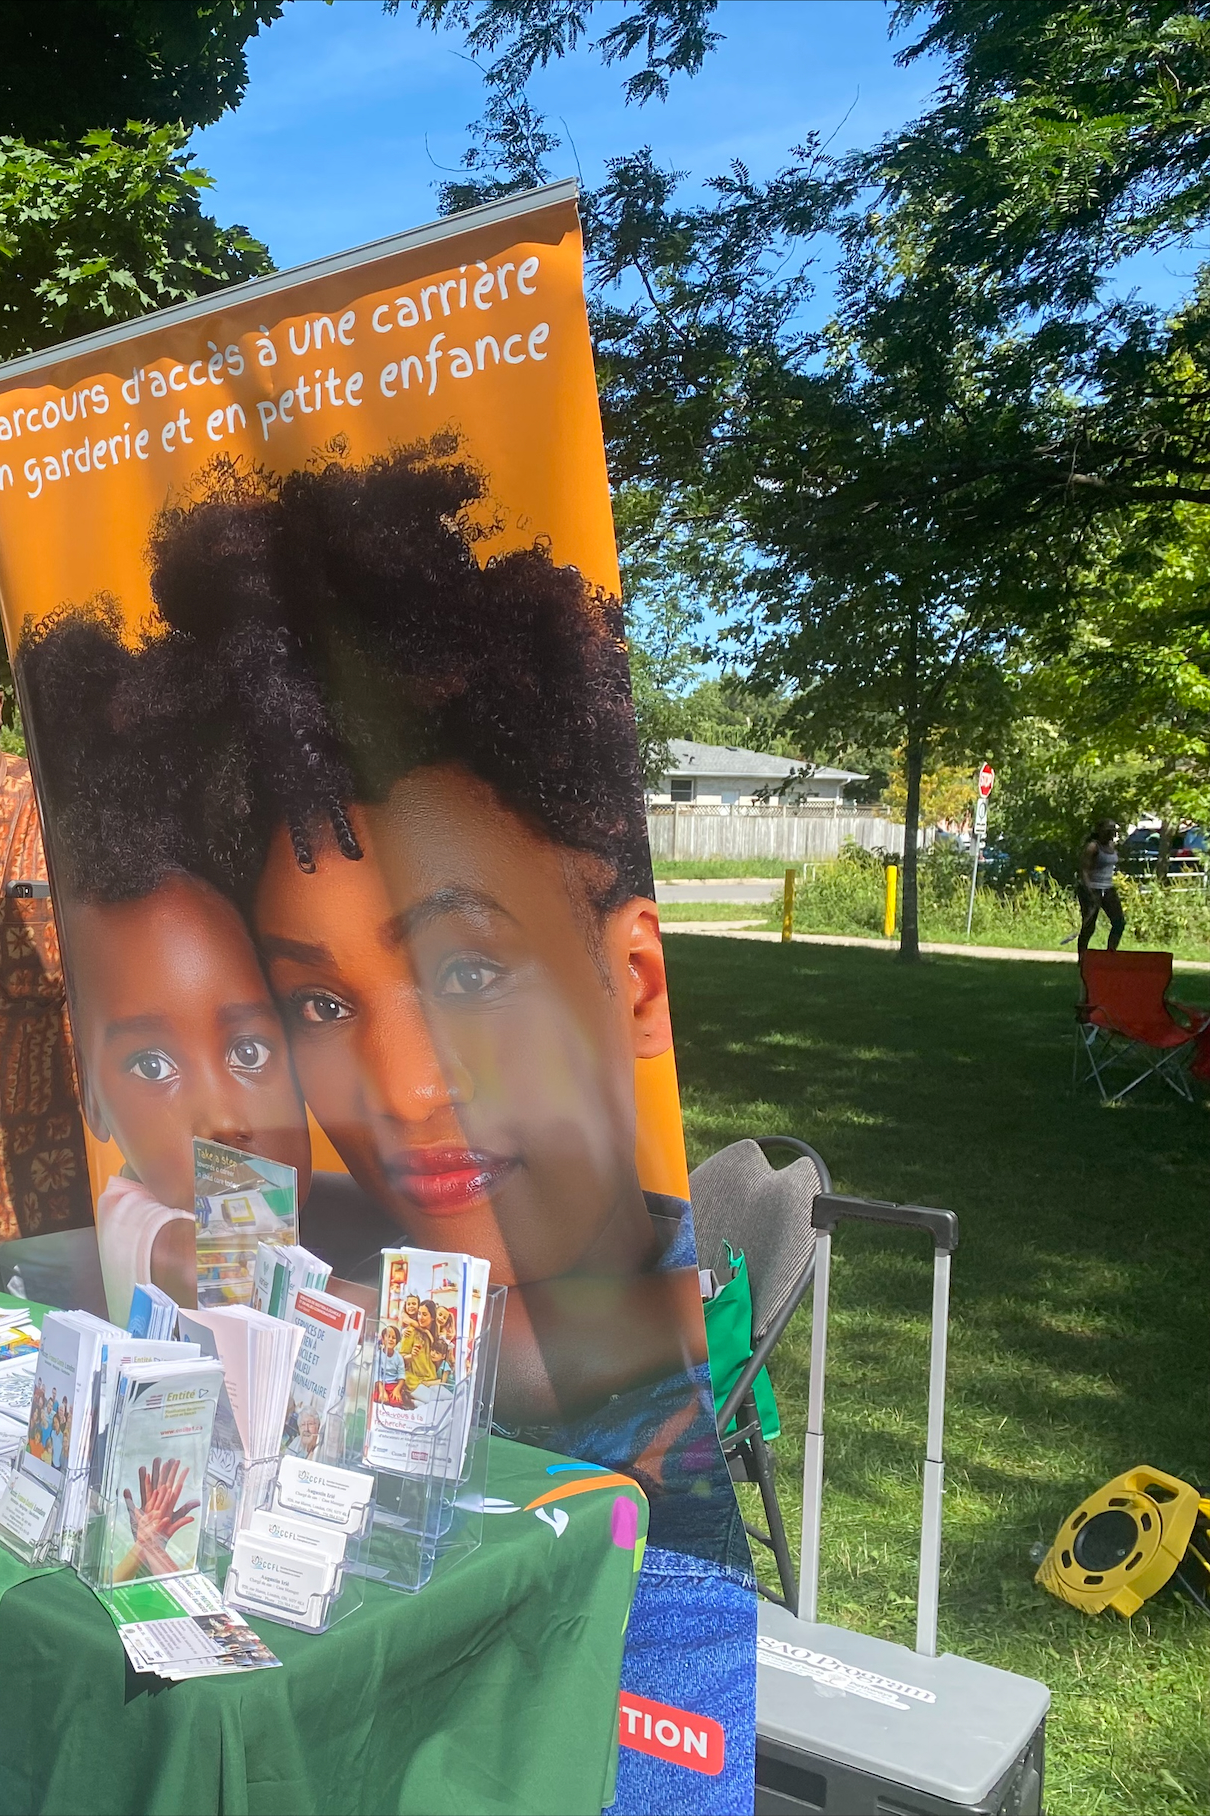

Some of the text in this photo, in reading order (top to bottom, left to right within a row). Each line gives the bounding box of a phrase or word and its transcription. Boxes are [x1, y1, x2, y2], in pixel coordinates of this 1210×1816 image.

[122, 340, 244, 405] d'accès
[258, 325, 276, 367] à
[290, 310, 356, 355] une
[372, 256, 540, 334] carrière
[24, 422, 149, 499] garderie
[162, 413, 193, 452] et
[207, 401, 246, 441] en
[256, 368, 363, 440] petite
[380, 322, 549, 397] enfance
[197, 1148, 213, 1161] Take
[221, 1155, 238, 1168] step
[167, 1389, 196, 1402] Entité
[377, 1408, 409, 1420] tes-vous
[310, 1476, 326, 1486] CCFL
[280, 1530, 296, 1540] CCFL
[263, 1561, 279, 1572] CCFL
[757, 1638, 811, 1659] SAO
[816, 1656, 931, 1700] Program
[618, 1705, 708, 1759] TION
